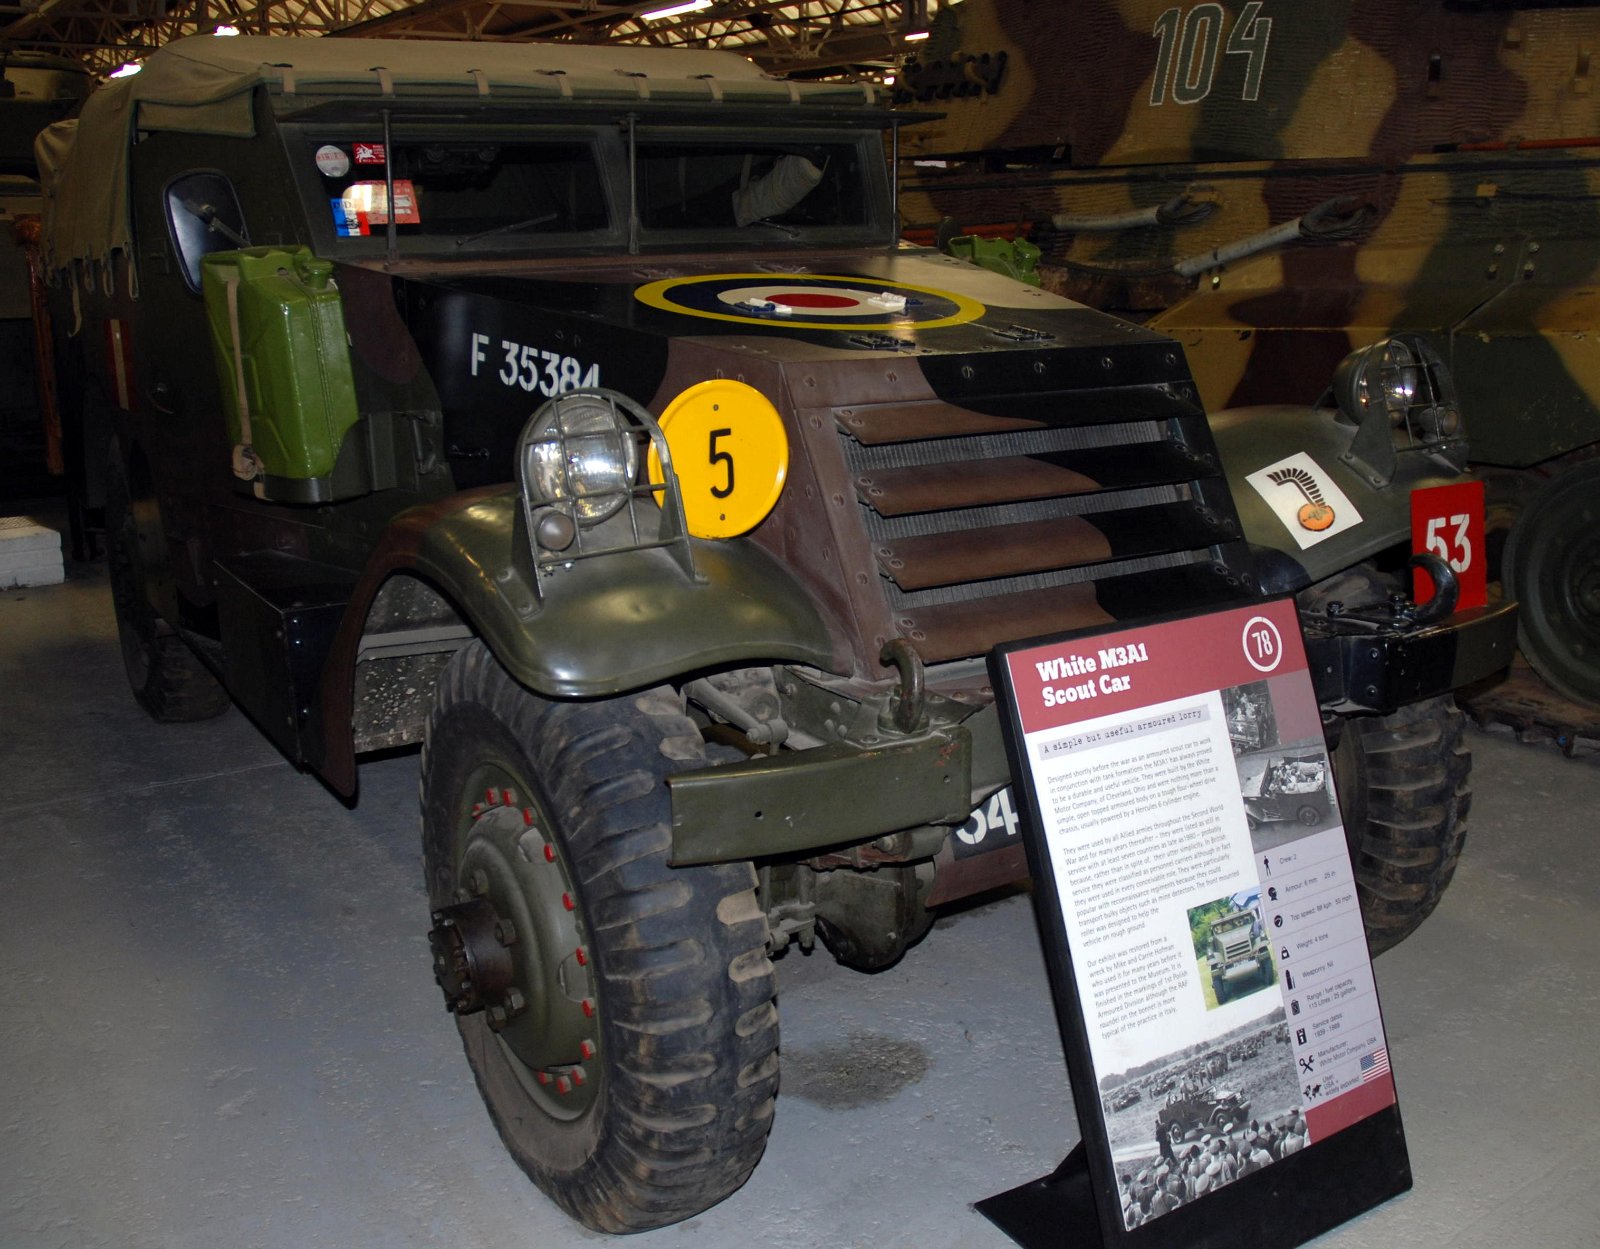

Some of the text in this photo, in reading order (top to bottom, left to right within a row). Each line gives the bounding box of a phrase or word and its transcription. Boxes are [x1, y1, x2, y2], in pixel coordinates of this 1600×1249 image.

[1149, 2, 1273, 106] 104
[471, 332, 489, 376] F
[708, 427, 735, 499] 5
[1426, 513, 1472, 573] 53
[1035, 643, 1149, 682] White M3A1
[1251, 630, 1273, 658] 78
[1042, 674, 1131, 707] Scout Car
[1053, 739, 1083, 751] simple
[1086, 733, 1102, 743] but
[1105, 725, 1134, 738] useful
[1137, 715, 1176, 731] armoured
[1178, 711, 1203, 720] lorry
[1047, 771, 1072, 784] Designed
[1073, 767, 1092, 777] shortly
[1092, 764, 1110, 772] before
[1110, 760, 1120, 768] the
[1145, 747, 1170, 759] armoured
[1170, 743, 1184, 752] scout
[1199, 736, 1211, 745] work
[1056, 780, 1088, 792] conjunction
[1089, 775, 1102, 784] with
[1102, 771, 1115, 780] tank
[1115, 765, 1143, 777] formations
[1143, 762, 1153, 770] the
[1179, 752, 1196, 760] always
[1196, 746, 1212, 758] proved
[1072, 788, 1092, 799] durable
[1093, 785, 1104, 794] and
[1104, 780, 1121, 791] useful
[1141, 773, 1154, 781] They
[1167, 765, 1179, 774] built
[1186, 761, 1195, 769] the
[1195, 758, 1210, 766] White
[1054, 805, 1071, 815] Motor
[1133, 785, 1146, 793] Ohio
[1146, 781, 1157, 790] and
[1157, 779, 1170, 787] were
[1170, 774, 1190, 783] nothing
[1190, 770, 1203, 778] more
[1203, 767, 1214, 775] than
[1057, 815, 1076, 825] simple,
[1076, 811, 1090, 820] open
[1090, 804, 1110, 816] topped
[1110, 797, 1135, 810] armoured
[1135, 795, 1149, 803] body
[1161, 786, 1176, 796] tough
[1176, 779, 1204, 792] four-wheel
[1080, 819, 1100, 829] usually
[1100, 811, 1123, 825] powered
[1135, 803, 1157, 814] Hercules
[1162, 796, 1182, 807] cylinder
[1063, 847, 1077, 855] They
[1077, 843, 1090, 851] were
[1091, 838, 1104, 847] used
[1119, 829, 1135, 839] Allied
[1135, 825, 1153, 834] armies
[1153, 815, 1181, 829] throughout
[1191, 808, 1209, 818] Second
[1209, 803, 1223, 813] World
[1065, 858, 1077, 866] War
[1078, 853, 1089, 862] and
[1098, 847, 1113, 856] many
[1114, 843, 1128, 853] years
[1128, 835, 1154, 847] thereafter
[1159, 830, 1171, 838] they
[1171, 827, 1184, 835] were
[1184, 821, 1198, 831] listed
[1205, 816, 1214, 825] still
[1087, 960, 1097, 968] Our
[1098, 952, 1116, 964] exhibit
[1117, 950, 1128, 958] was
[1128, 941, 1150, 954] restored
[1150, 938, 1163, 946] from
[1094, 990, 1104, 999] was
[1105, 979, 1131, 996] presented
[1138, 975, 1147, 983] the
